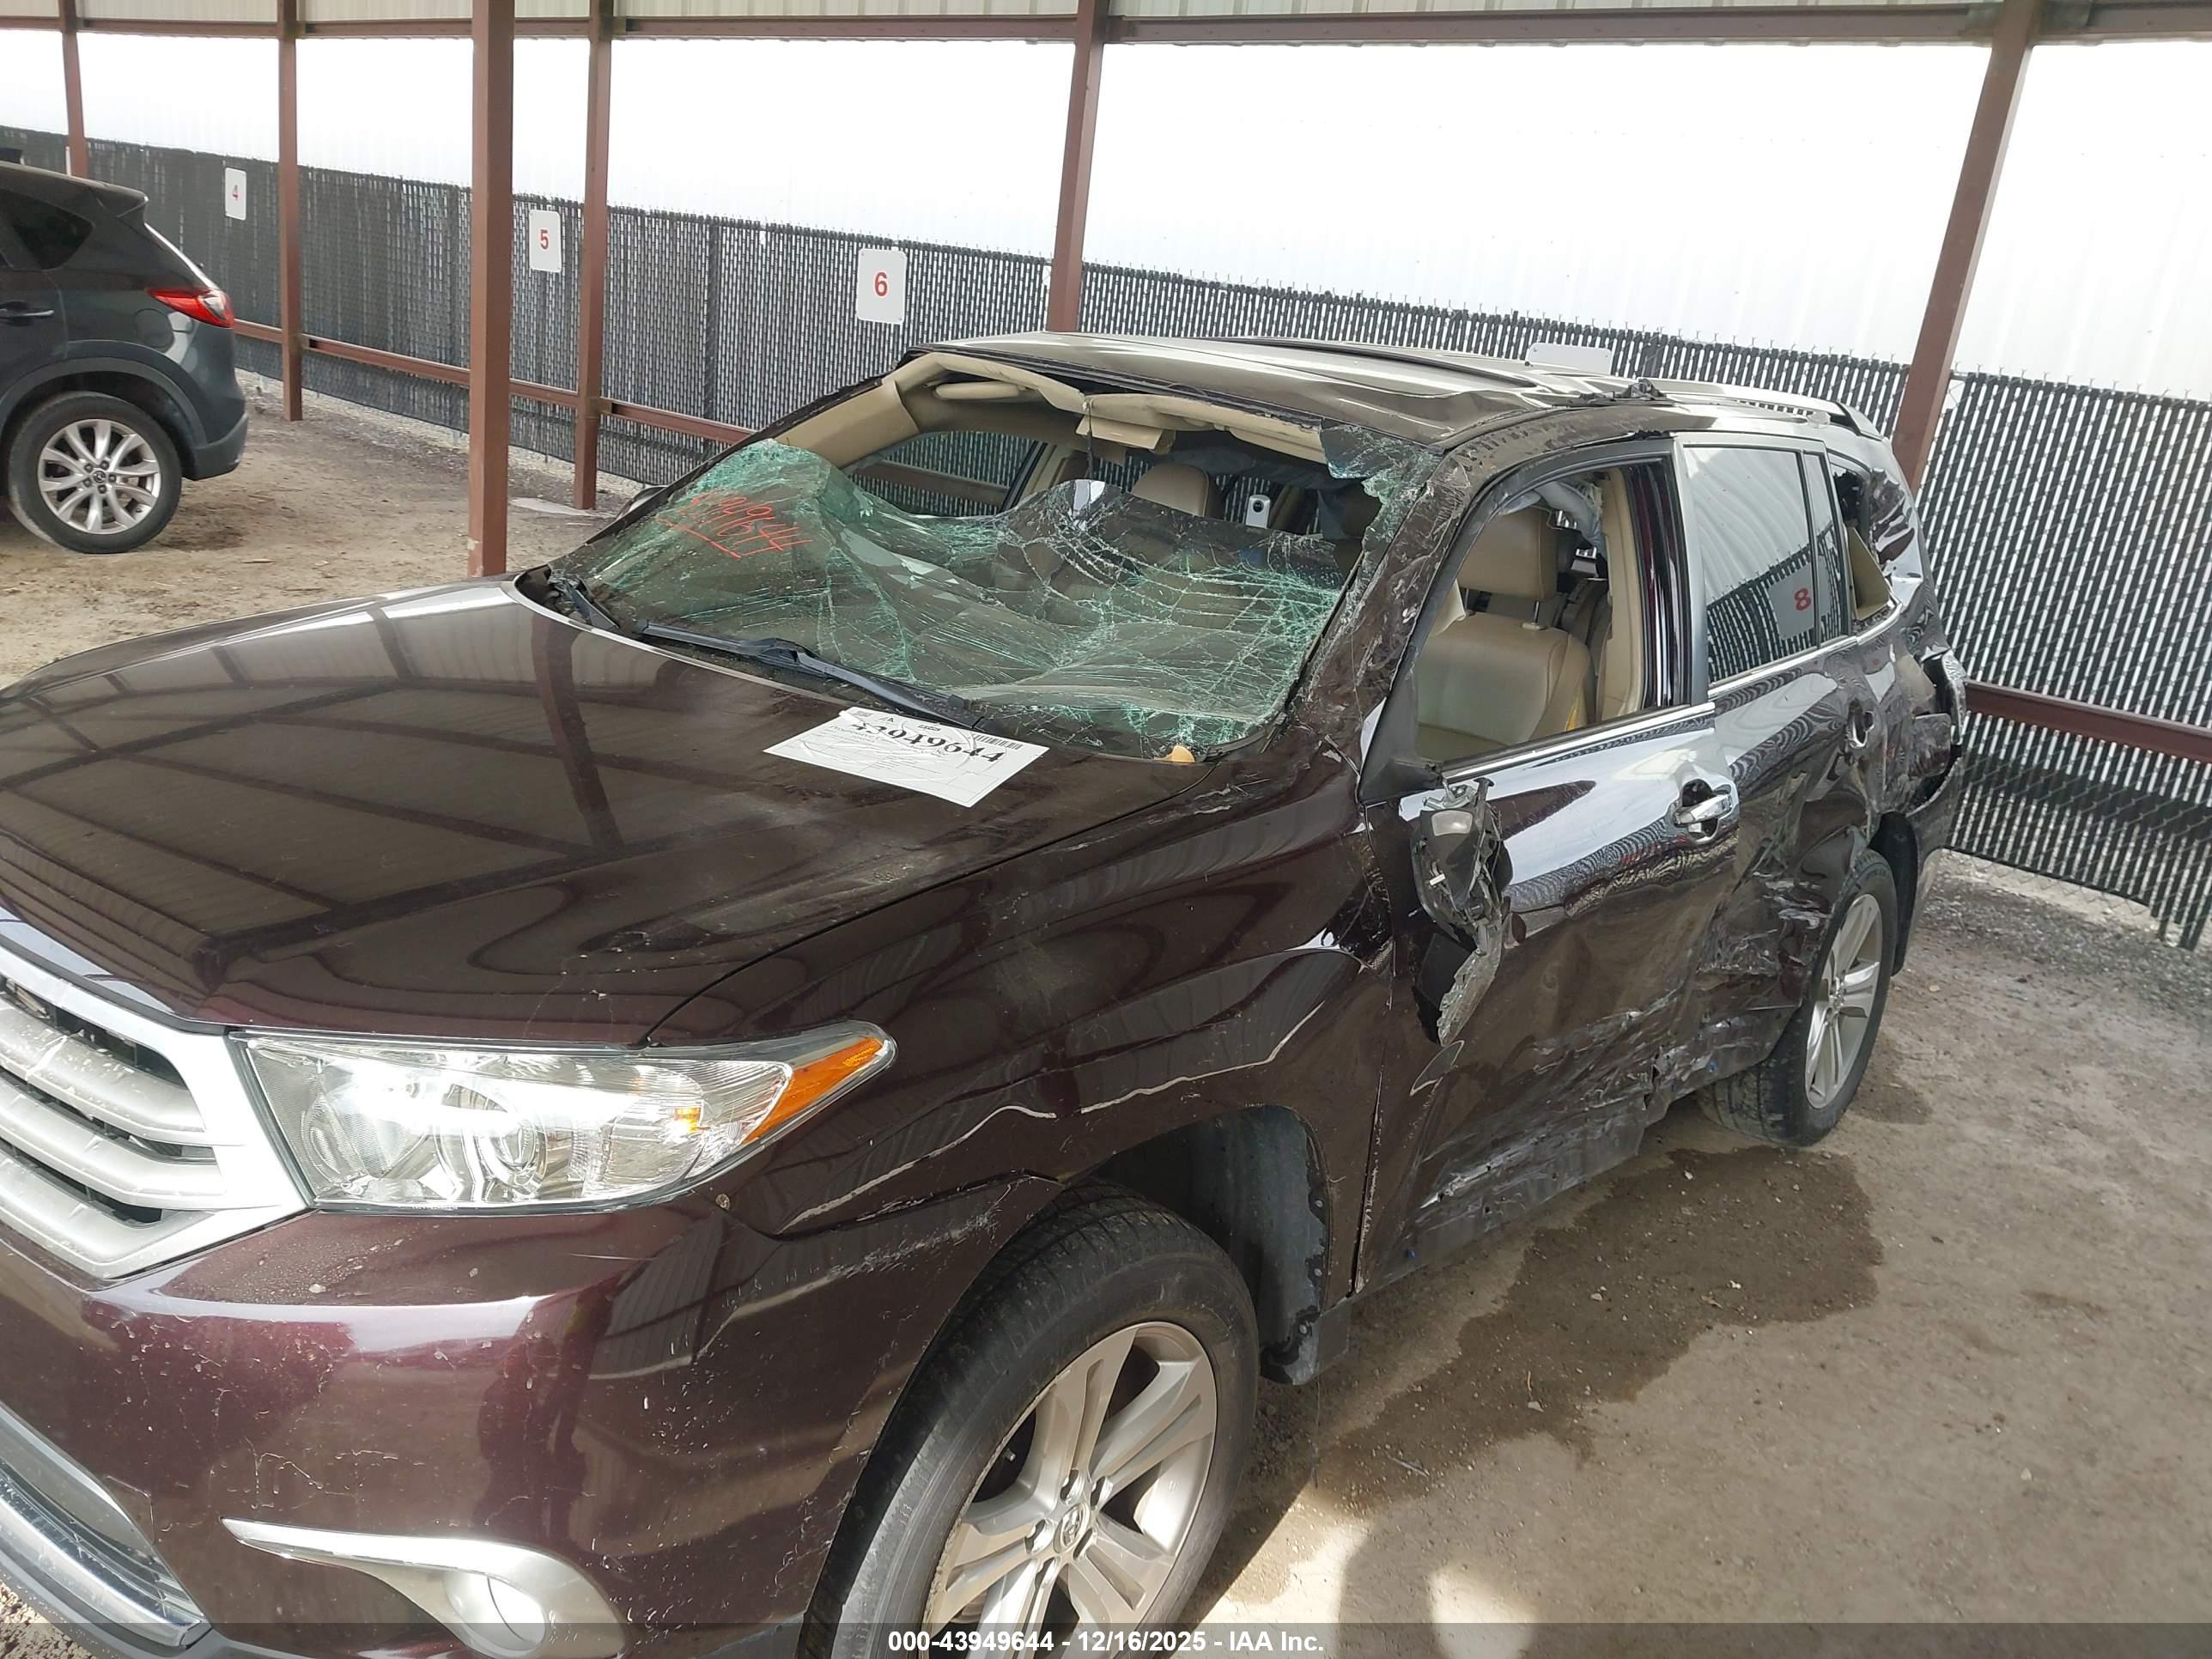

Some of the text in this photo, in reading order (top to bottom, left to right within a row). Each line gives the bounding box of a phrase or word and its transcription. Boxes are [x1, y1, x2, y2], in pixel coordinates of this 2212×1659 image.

[539, 228, 550, 250] 5
[874, 271, 888, 297] 6
[678, 490, 812, 556] 949644
[852, 722, 1006, 763] 43949644
